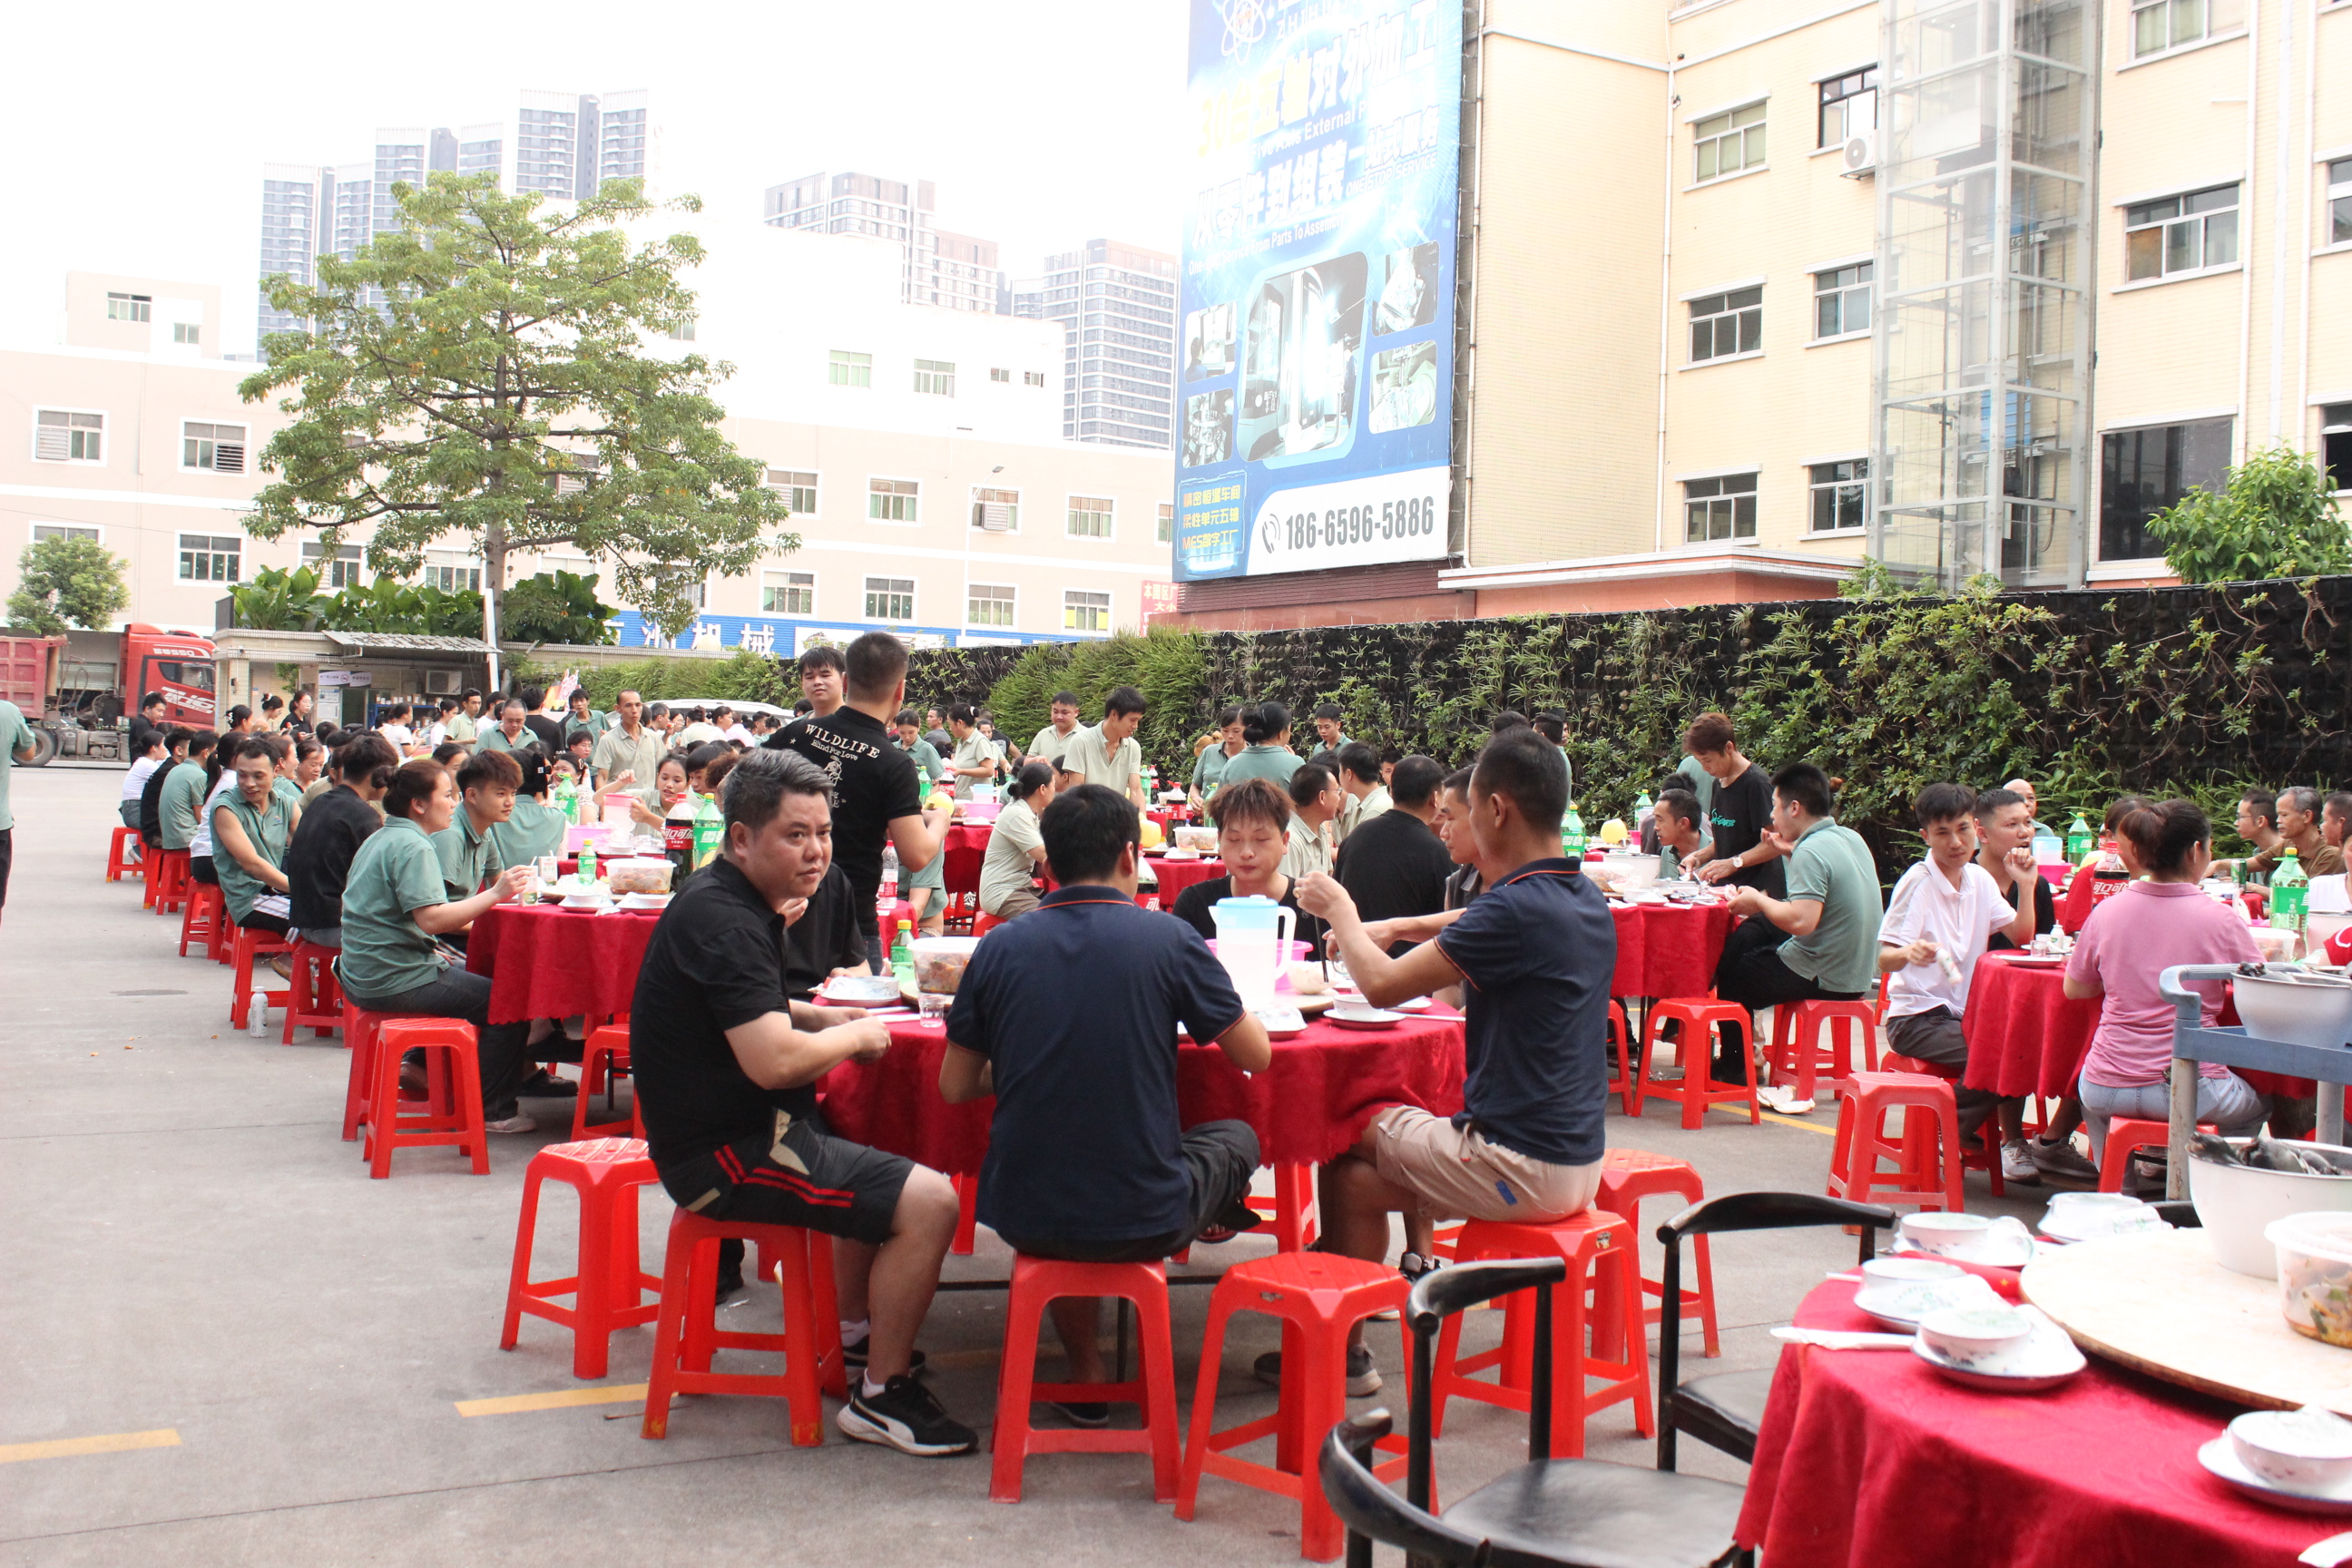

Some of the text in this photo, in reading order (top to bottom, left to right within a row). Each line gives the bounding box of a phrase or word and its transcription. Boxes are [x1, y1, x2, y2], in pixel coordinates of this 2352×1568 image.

[1197, 1, 1438, 158] 30台五轴对外加工
[1250, 142, 1274, 161] Five
[1304, 109, 1356, 140] External
[1346, 152, 1437, 197] ONE STOP SERVICE
[1221, 242, 1250, 265] Service
[1250, 235, 1270, 256] From
[1271, 227, 1292, 250] Parts
[1293, 223, 1303, 241] To
[1304, 211, 1345, 238] Assembly
[1182, 484, 1241, 508] 精密恒温车间
[1182, 507, 1240, 529] 柔性单元五轴
[1286, 495, 1435, 550] 186-6596-5886
[805, 724, 880, 759] WILDLIFE
[841, 750, 858, 761] Love
